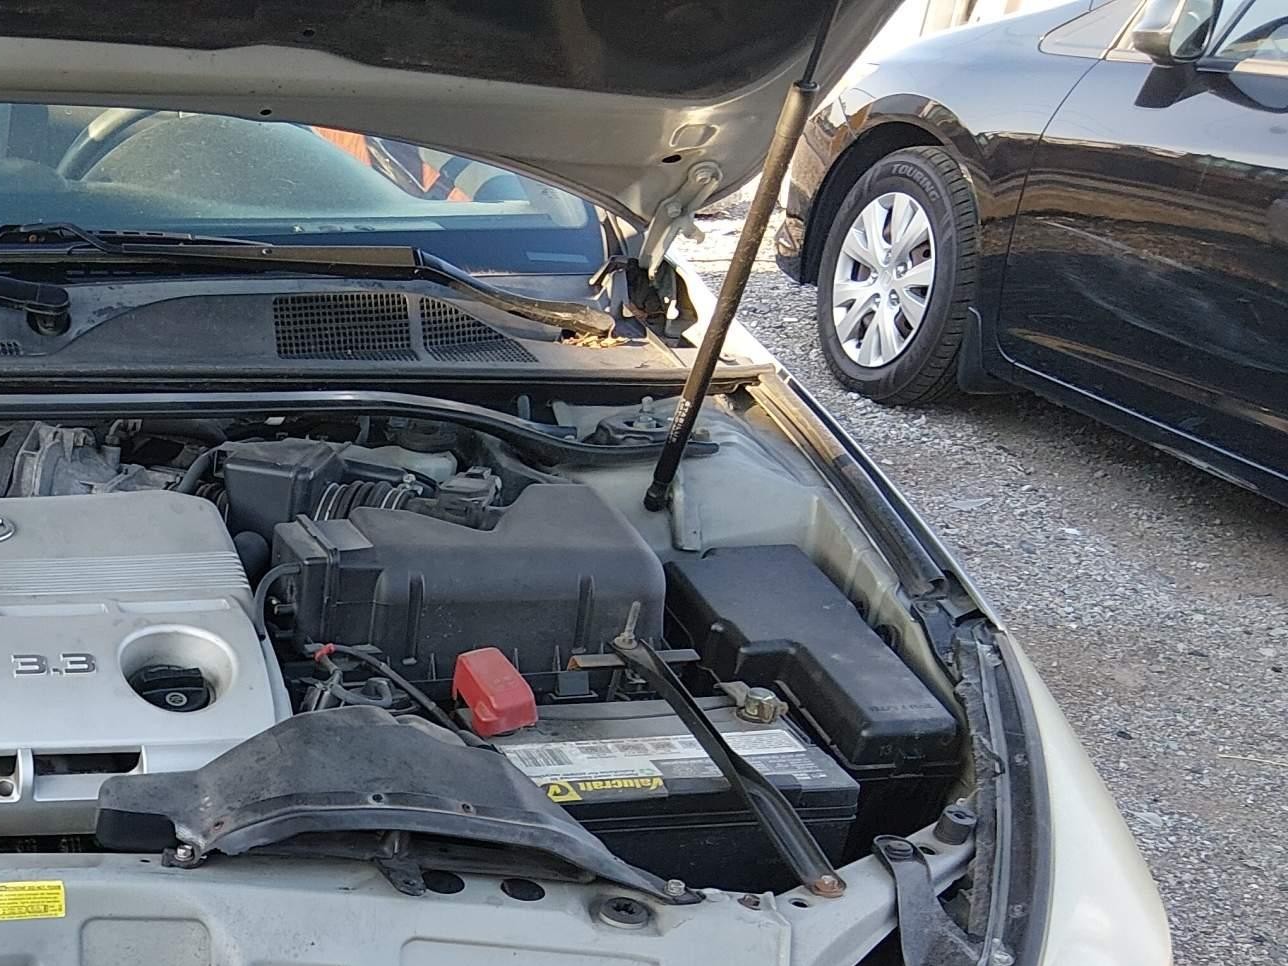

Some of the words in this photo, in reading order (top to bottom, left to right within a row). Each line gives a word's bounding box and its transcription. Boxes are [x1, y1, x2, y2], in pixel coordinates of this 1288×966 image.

[891, 163, 941, 202] TOURING
[11, 652, 97, 678] 3.3
[577, 777, 664, 791] Valucraft
